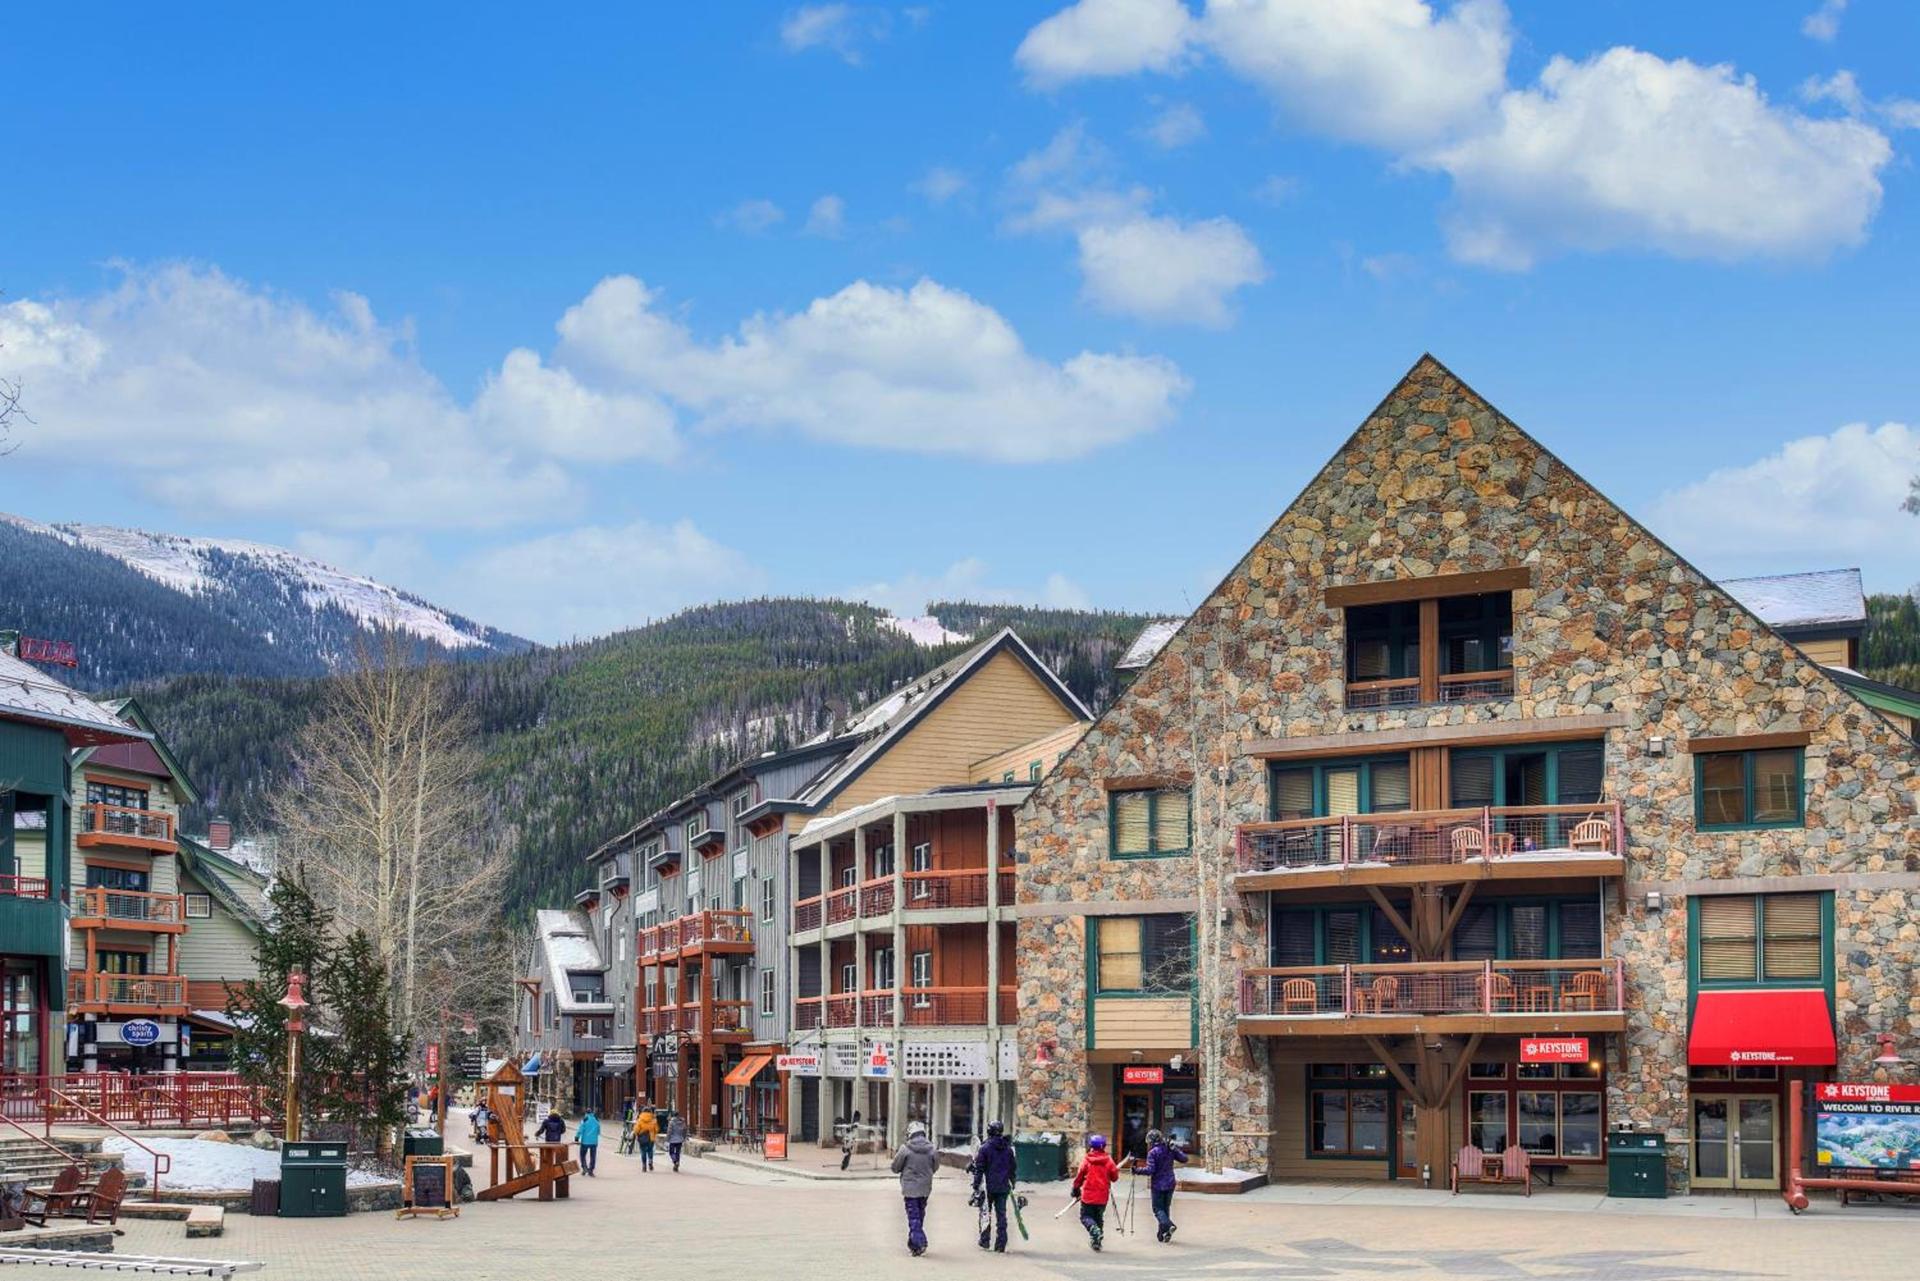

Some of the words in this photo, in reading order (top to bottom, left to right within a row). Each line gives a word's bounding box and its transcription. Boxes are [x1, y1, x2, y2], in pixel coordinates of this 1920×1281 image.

[1539, 1042, 1583, 1053] KEYSTONE
[1741, 1051, 1776, 1061] KEYSTONE
[788, 1057, 816, 1066] KEYSTONE
[1841, 1085, 1890, 1097] KEYSTONE
[1823, 1103, 1868, 1112] WELCOME
[1870, 1104, 1883, 1112] TO
[1885, 1105, 1912, 1113] RIVER
